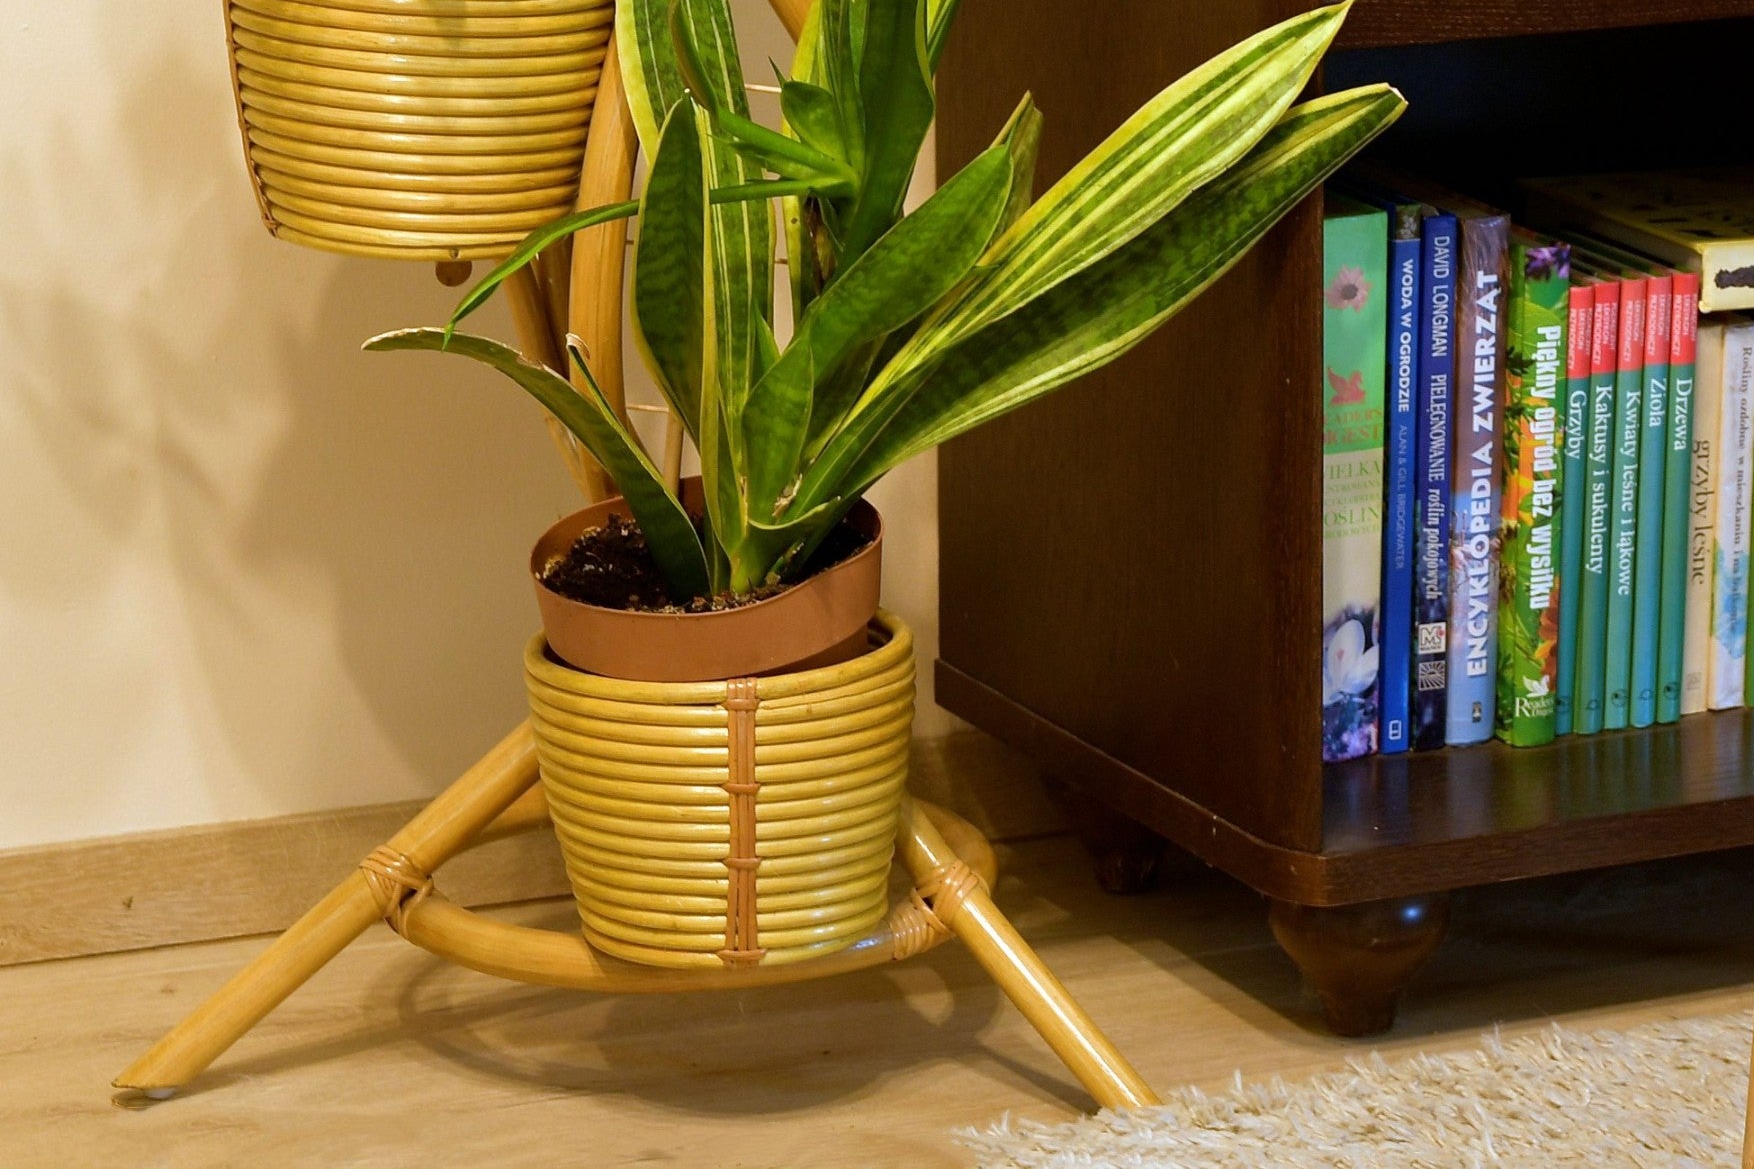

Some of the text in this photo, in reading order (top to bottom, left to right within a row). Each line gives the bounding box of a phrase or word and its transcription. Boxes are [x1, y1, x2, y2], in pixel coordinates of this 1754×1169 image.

[1431, 235, 1451, 358] DAVID LONGMAN
[1398, 259, 1414, 413] WODA W OGRODZIE
[1738, 346, 1753, 394] Rośliny
[1564, 390, 1587, 460] Grzyby
[1589, 385, 1613, 464] Kaktusy
[1620, 390, 1641, 458] Kwiaty
[1649, 378, 1667, 428] Zioła
[1674, 377, 1693, 451] Drzewa
[1738, 397, 1749, 450] ozdobne
[1396, 424, 1408, 570] ALAN & GILL BRIDGEWATER
[1423, 373, 1448, 600] PIELĘGNOWANIE roślin pokojowych
[1466, 270, 1502, 677] ENCYKLOPEDIA ZWIERZĄT
[1525, 324, 1562, 610] Piękny ogród bez wysiłku
[1621, 464, 1638, 512] leśne
[1737, 455, 1745, 466] w
[1585, 482, 1608, 575] sukulenty
[1690, 440, 1715, 585] grzyby leśne
[1616, 530, 1636, 596] łąkowe
